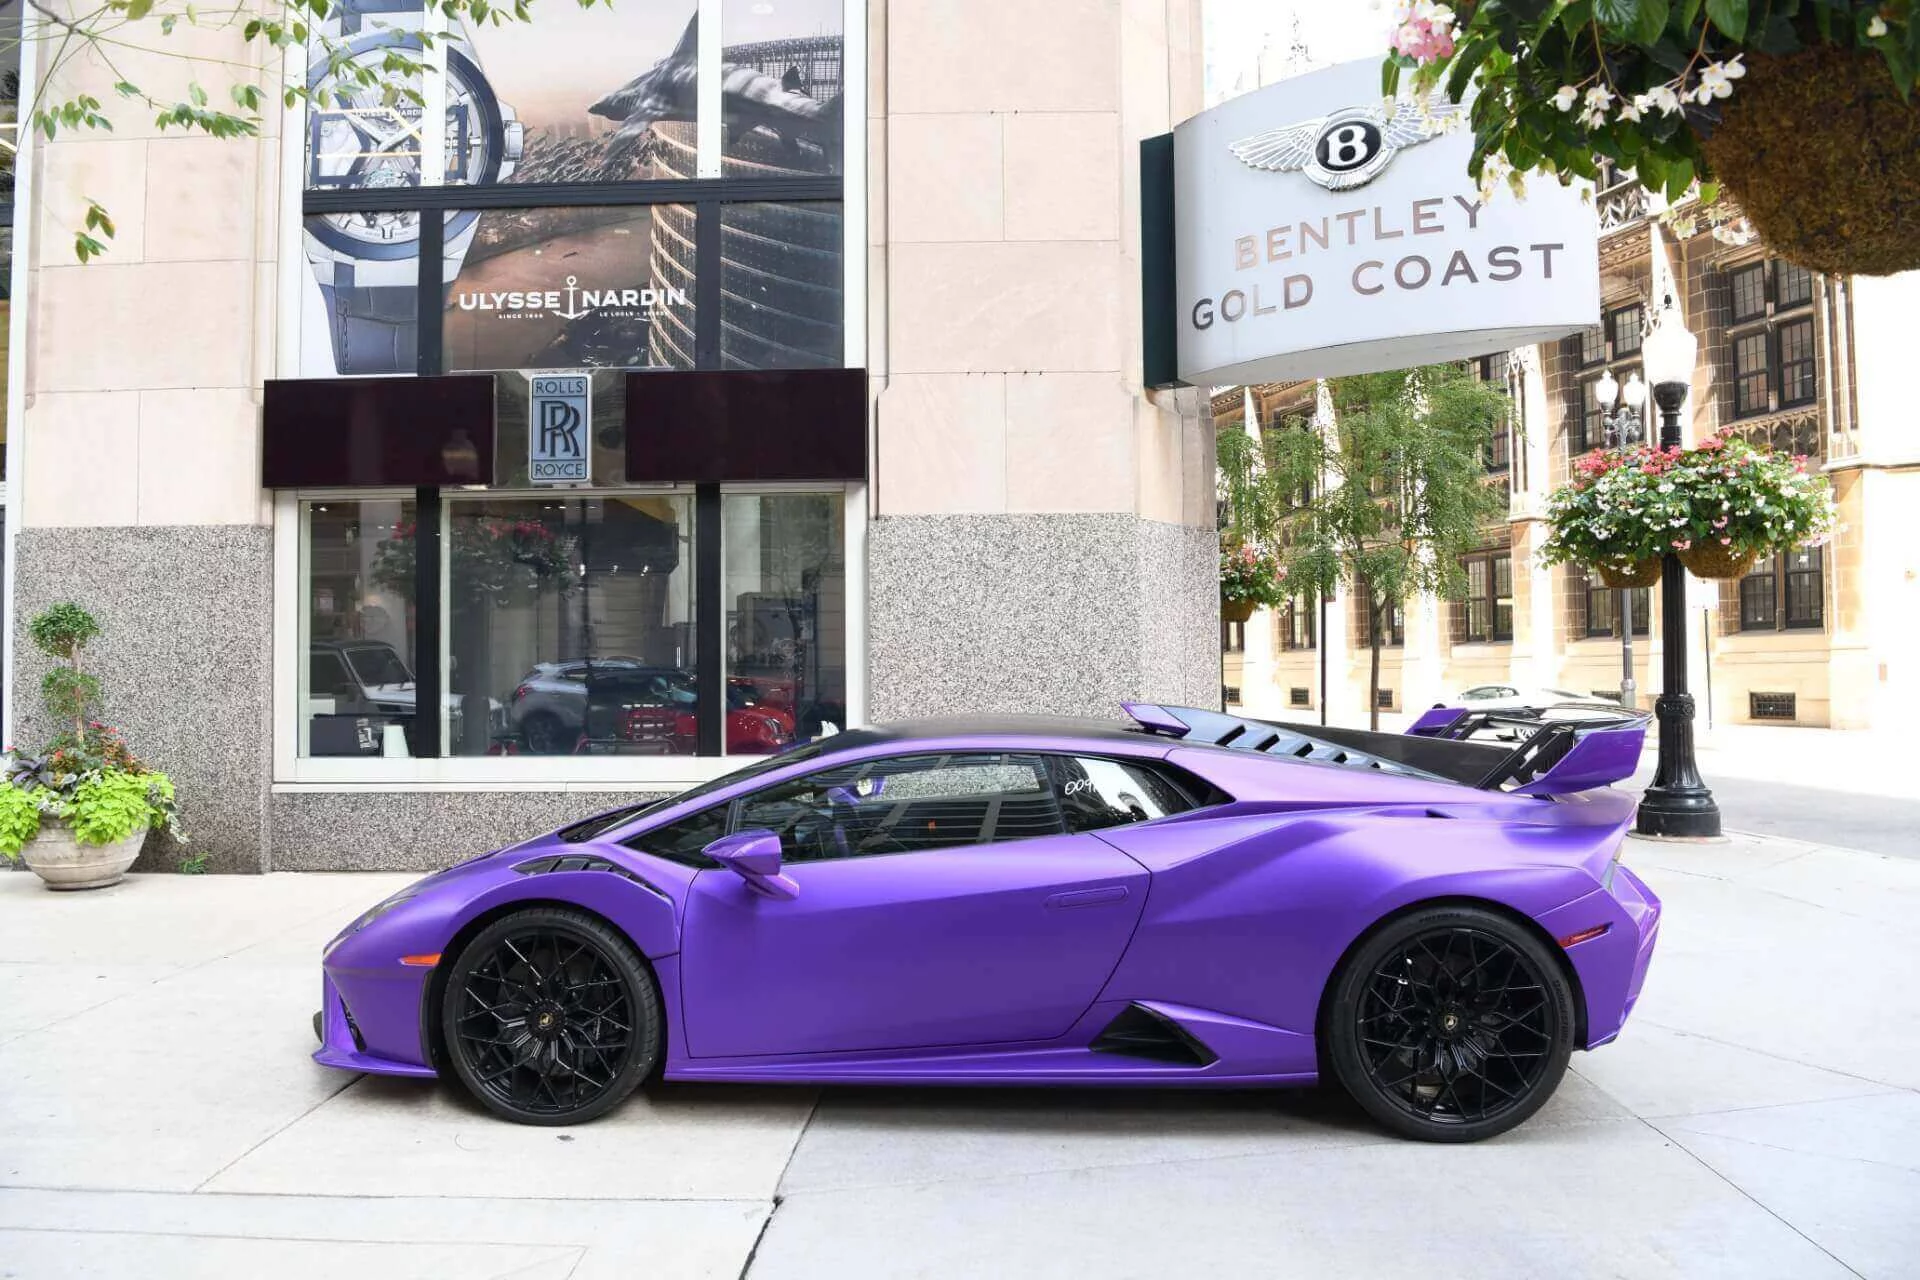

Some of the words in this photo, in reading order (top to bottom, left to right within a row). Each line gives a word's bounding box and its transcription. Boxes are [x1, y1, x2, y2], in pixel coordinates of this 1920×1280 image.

[1326, 123, 1369, 166] B
[1234, 194, 1483, 271] BENTLEY
[459, 291, 561, 310] ULYSSE
[582, 288, 686, 307] NARDIN
[1191, 273, 1314, 331] GOLD
[1351, 243, 1564, 296] COAST
[535, 380, 584, 394] ROLLS
[534, 463, 584, 477] ROYCE
